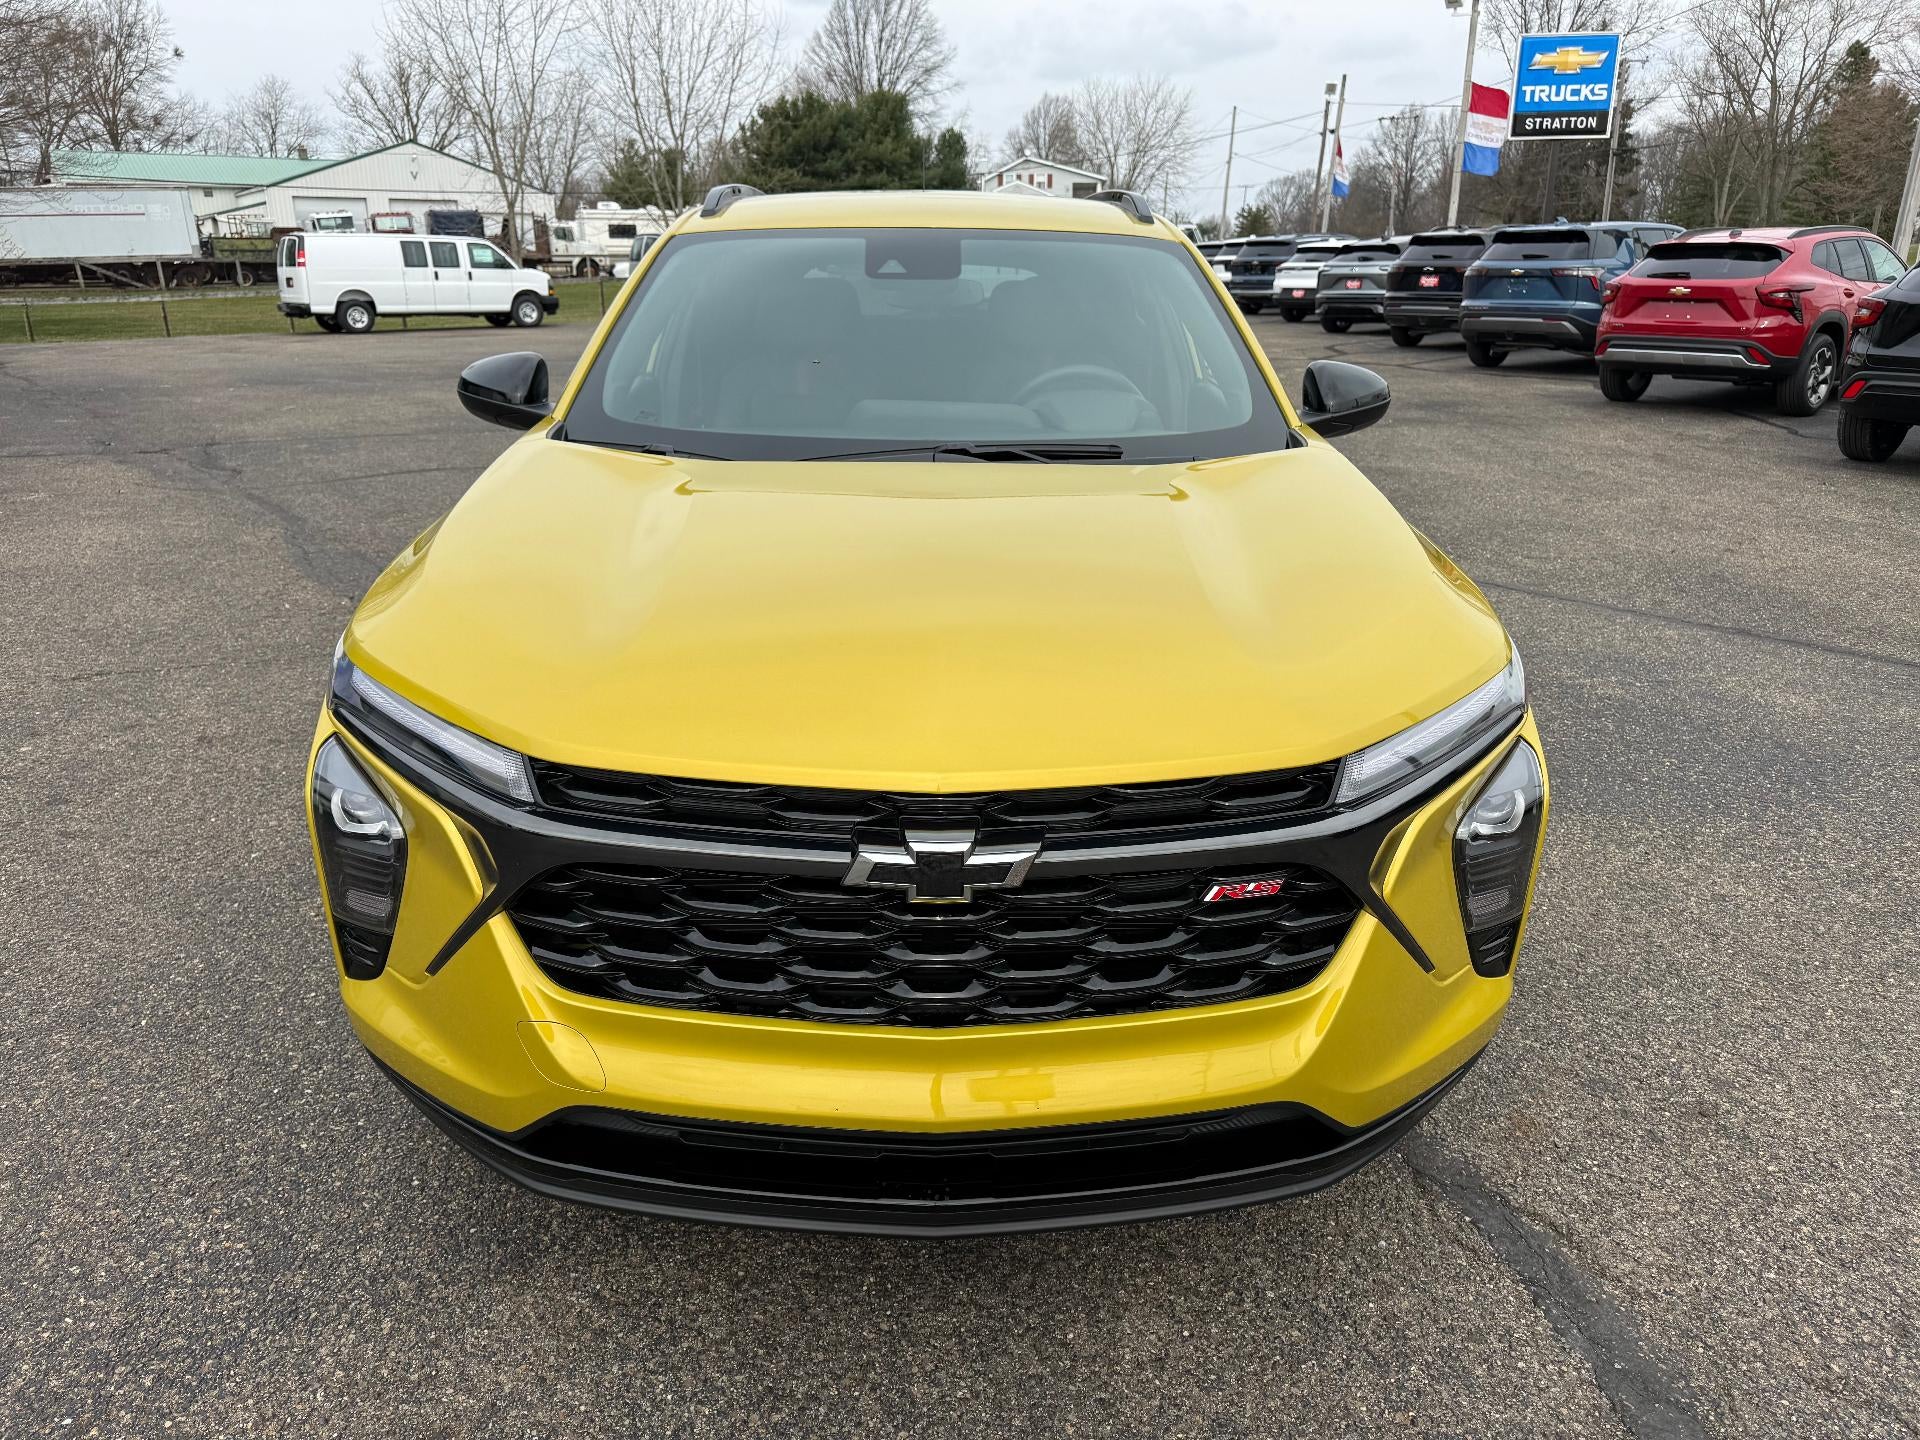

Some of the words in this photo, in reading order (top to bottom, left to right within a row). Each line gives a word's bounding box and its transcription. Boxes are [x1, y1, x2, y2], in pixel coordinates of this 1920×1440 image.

[1522, 84, 1608, 103] TRUCKS
[1524, 116, 1597, 130] STRATTON
[1203, 878, 1286, 902] RS
